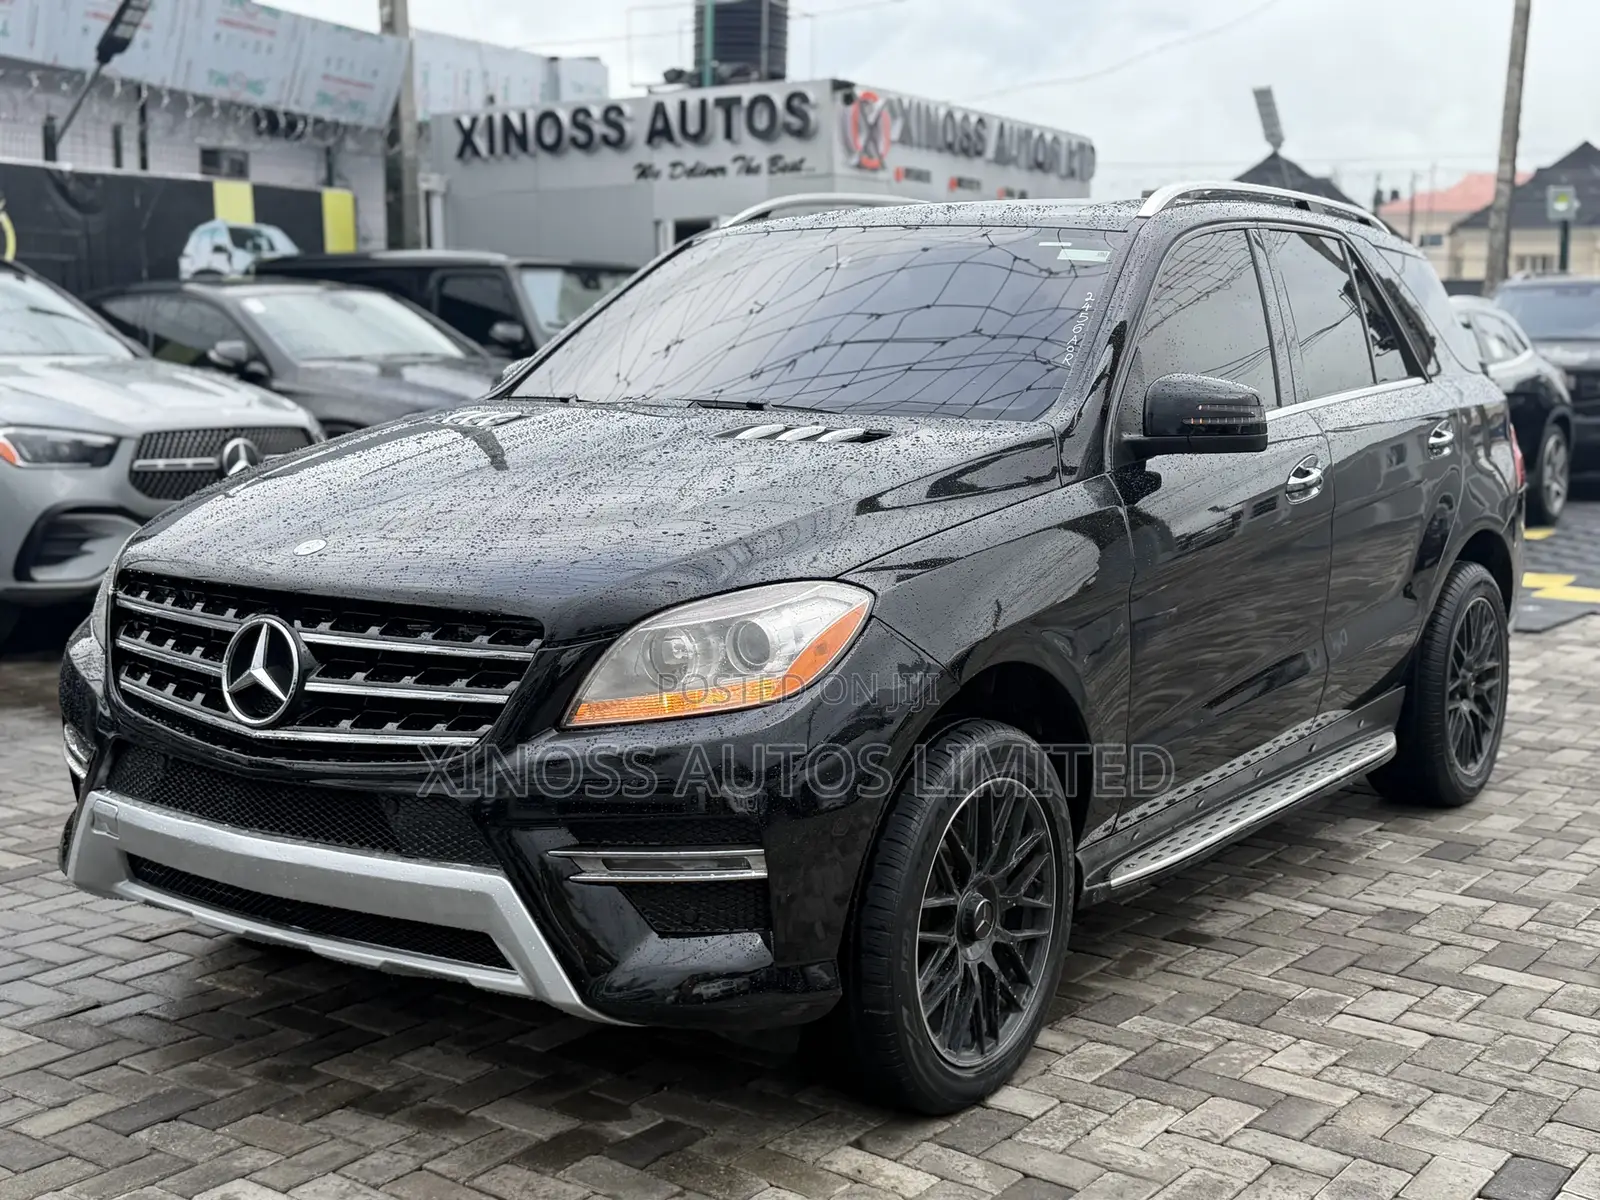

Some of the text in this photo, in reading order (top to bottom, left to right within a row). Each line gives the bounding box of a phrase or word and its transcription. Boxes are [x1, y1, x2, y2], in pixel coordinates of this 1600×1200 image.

[455, 91, 816, 158] XINOSS AUTOS
[894, 97, 987, 158] XINOSS
[732, 154, 762, 176] The
